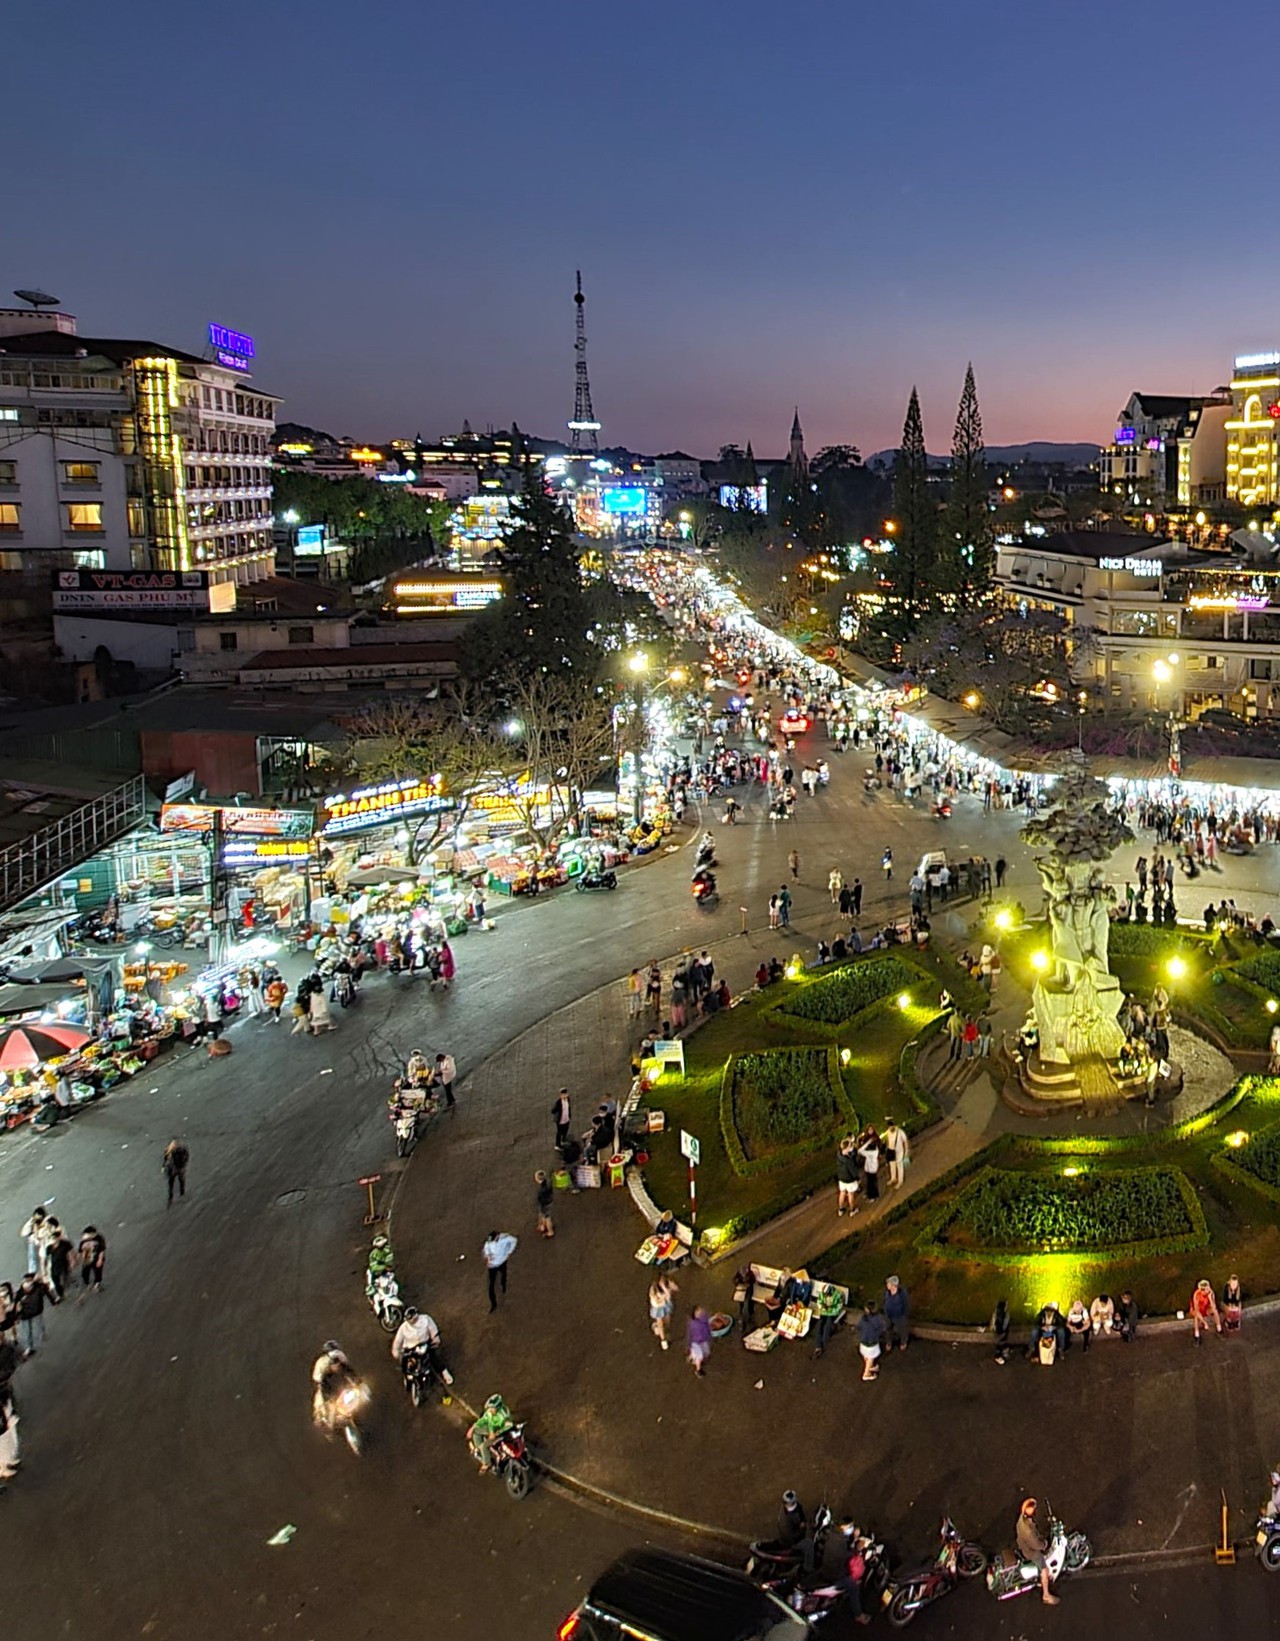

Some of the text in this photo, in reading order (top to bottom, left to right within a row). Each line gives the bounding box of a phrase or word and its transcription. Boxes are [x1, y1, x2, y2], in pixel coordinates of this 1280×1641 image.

[1099, 557, 1162, 569] NICE DREAM
[91, 574, 176, 588] VT-GAS
[60, 594, 96, 602] DNTN
[103, 594, 134, 602] GAS
